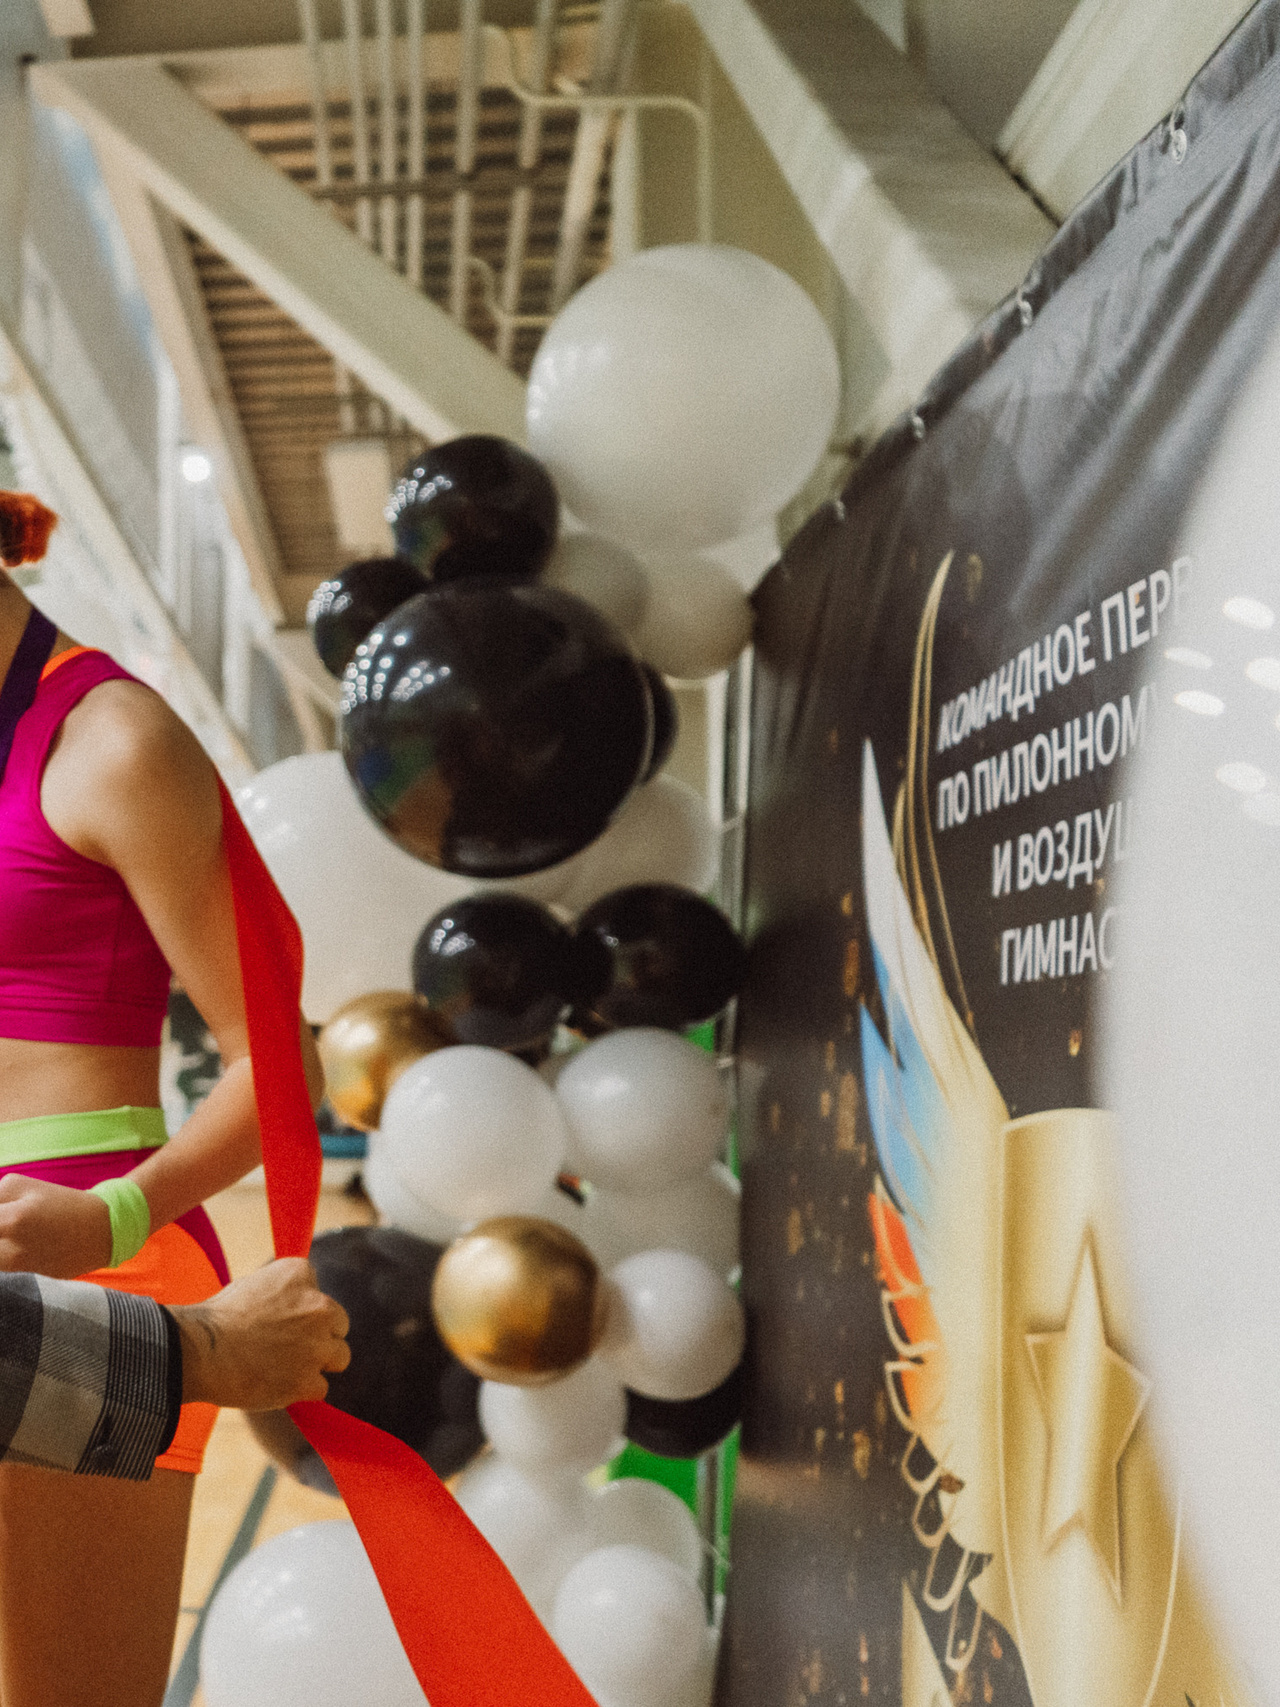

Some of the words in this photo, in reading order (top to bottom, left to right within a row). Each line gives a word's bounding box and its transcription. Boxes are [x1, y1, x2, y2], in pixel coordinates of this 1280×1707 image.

[937, 611, 1097, 752] КОМАНДНОЕ
[937, 770, 970, 832] ПО
[992, 839, 1013, 899] И
